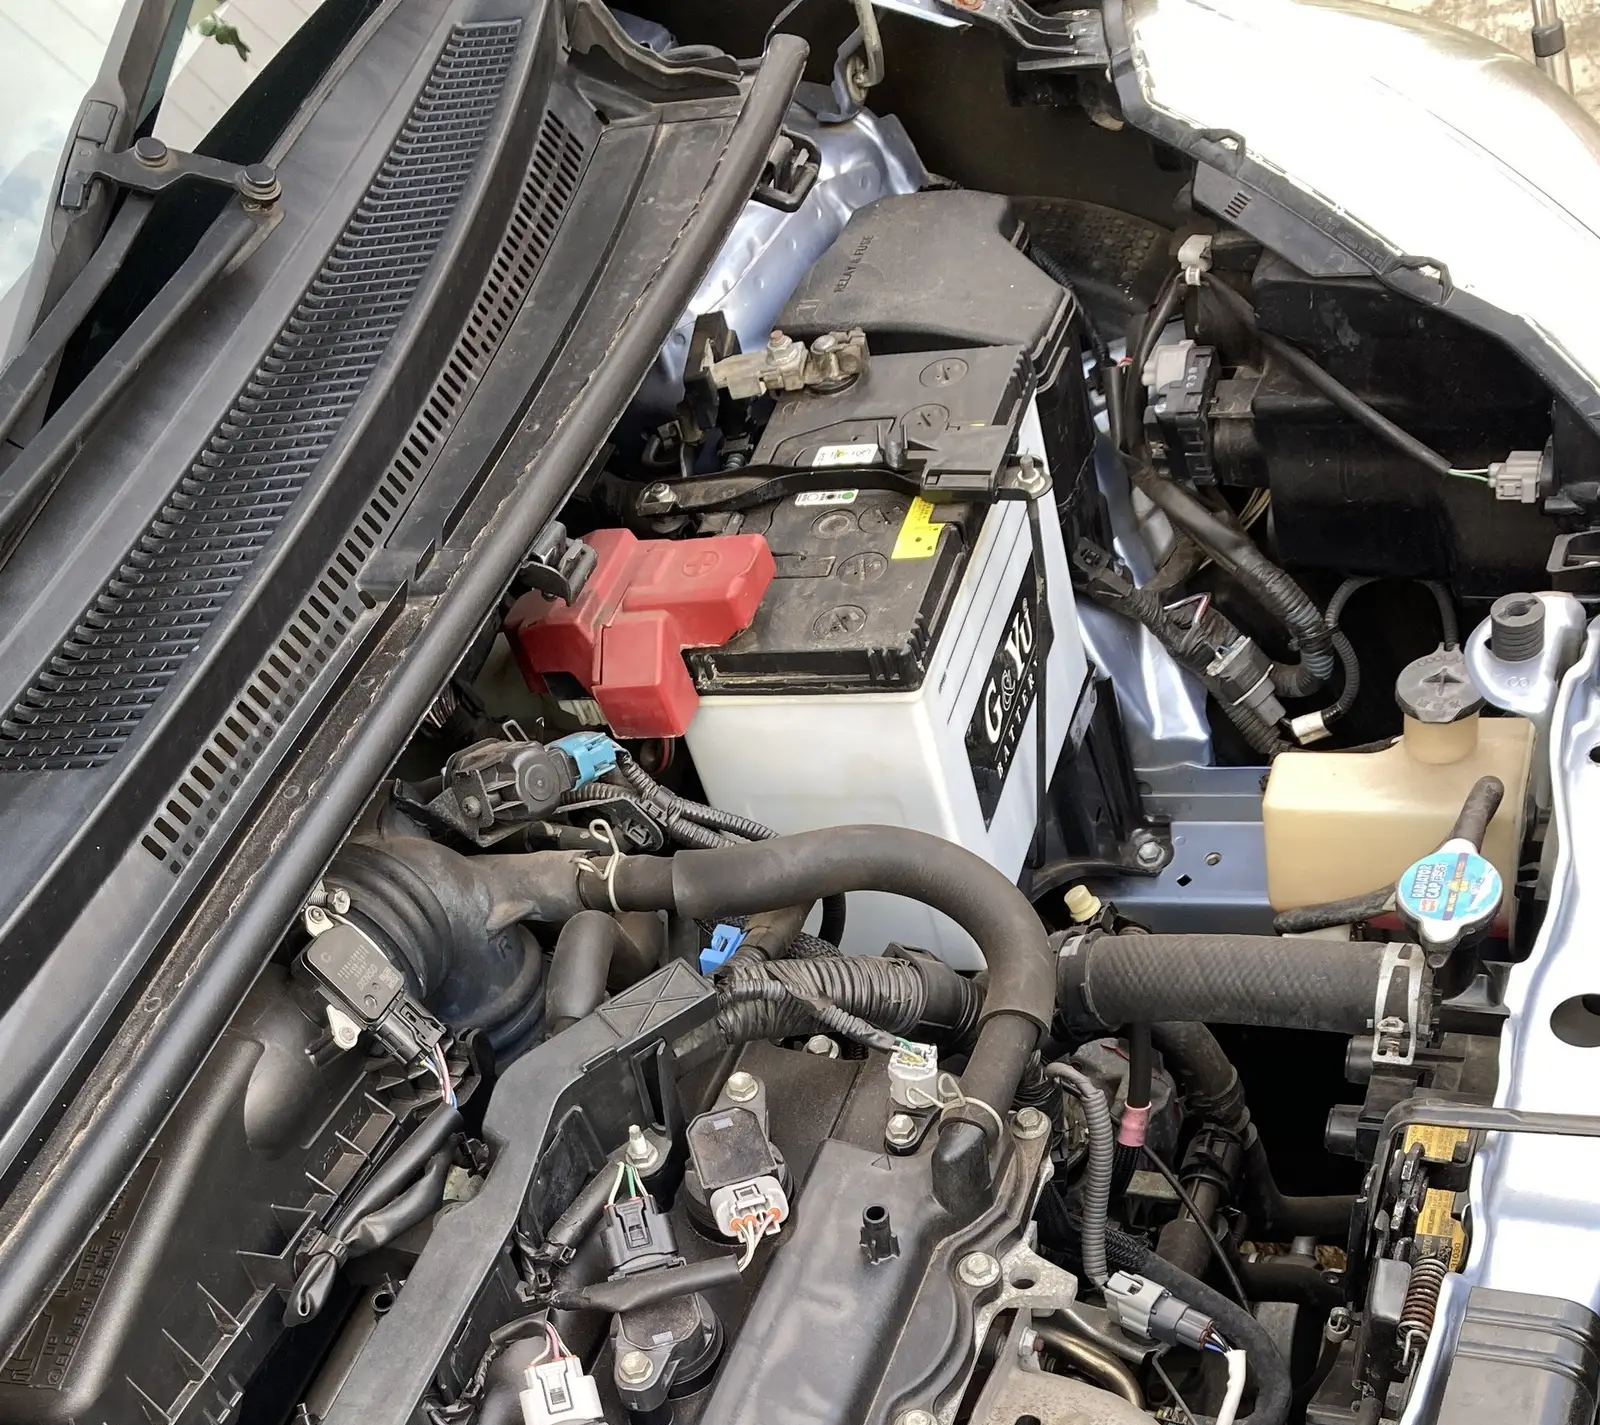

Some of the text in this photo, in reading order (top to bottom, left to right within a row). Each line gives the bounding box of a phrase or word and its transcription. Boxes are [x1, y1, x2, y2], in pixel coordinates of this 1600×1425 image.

[833, 265, 857, 293] RELAY
[854, 235, 875, 256] FUSE
[1411, 863, 1434, 898] RADIATOR
[1425, 879, 1443, 899] CAP
[356, 963, 378, 991] DENSO
[72, 1243, 102, 1293] SLIDE
[55, 1298, 94, 1368] ELEMENT
[89, 1230, 126, 1289] REMOVE
[42, 1335, 59, 1357] UP
